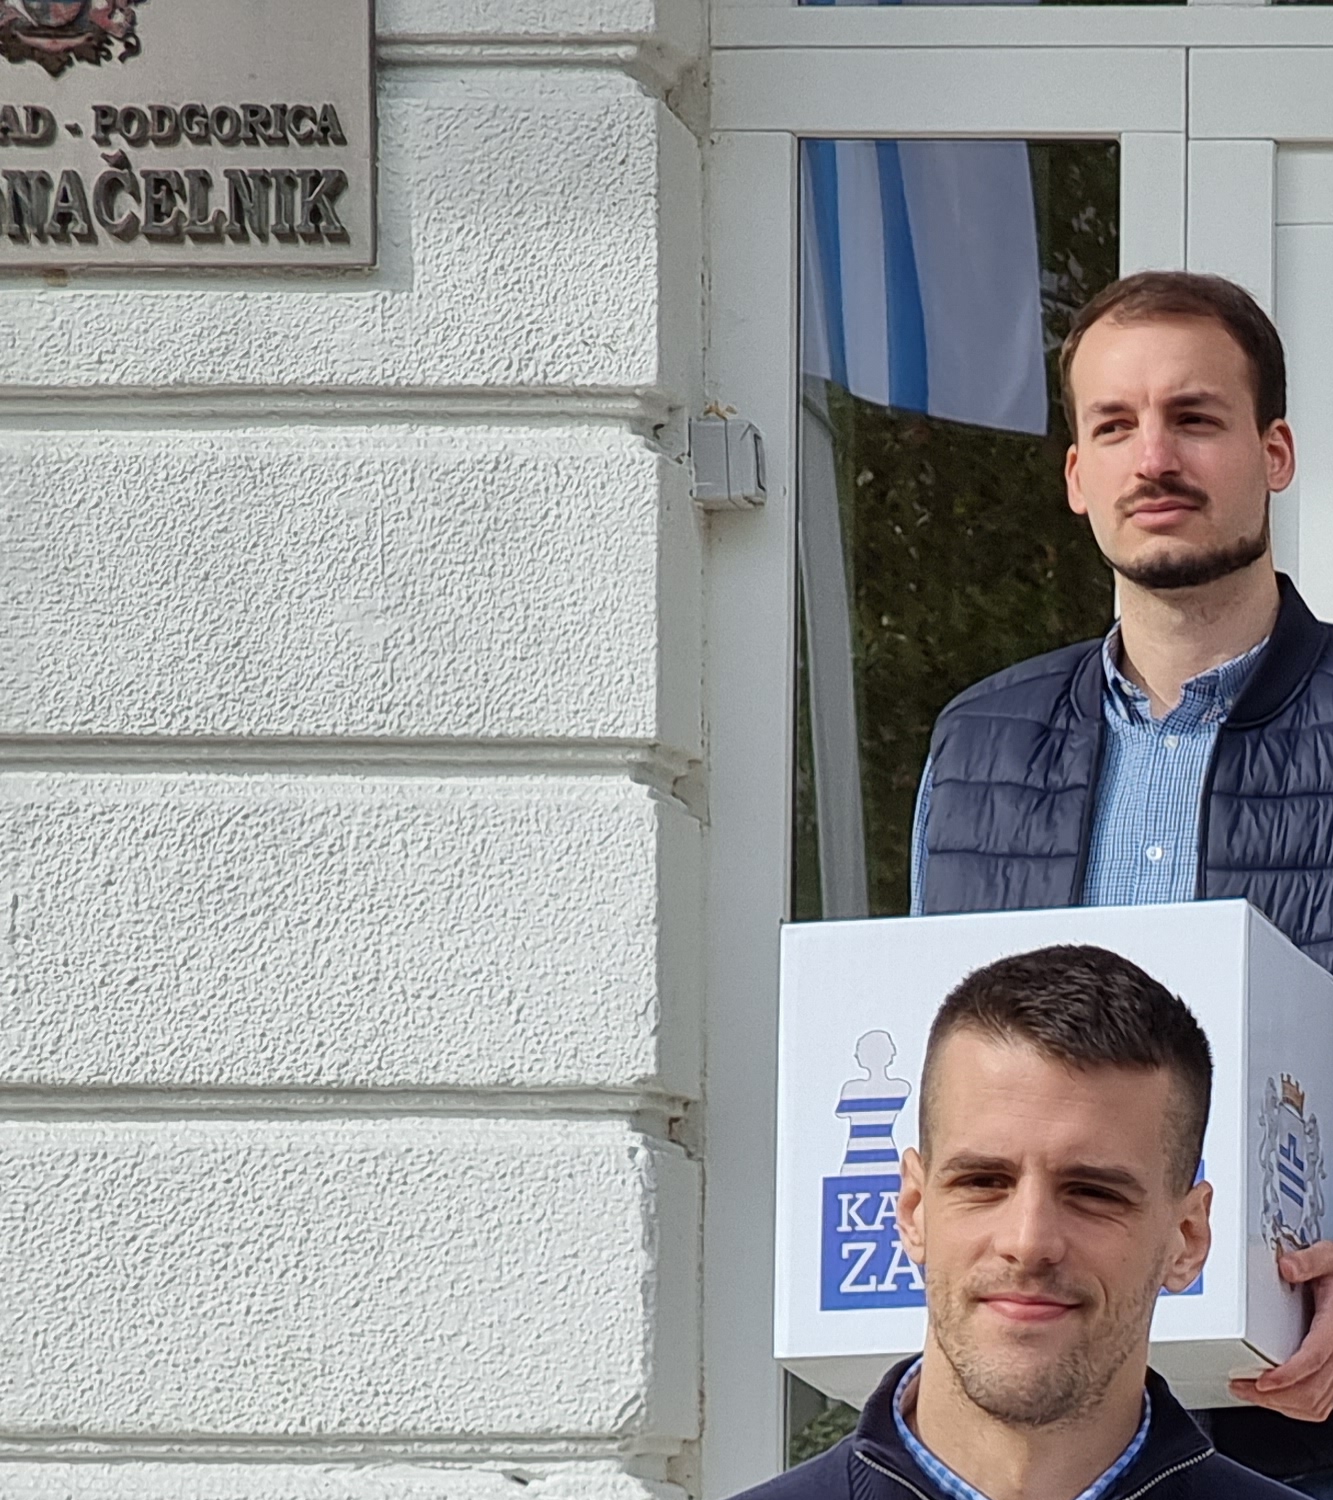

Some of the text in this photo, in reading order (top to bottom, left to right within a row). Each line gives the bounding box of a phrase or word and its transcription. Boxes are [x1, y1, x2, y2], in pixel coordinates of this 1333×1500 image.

[91, 103, 348, 147] PODGORICA
[0, 149, 350, 245] NAČELNIK
[839, 1240, 926, 1293] ZA
